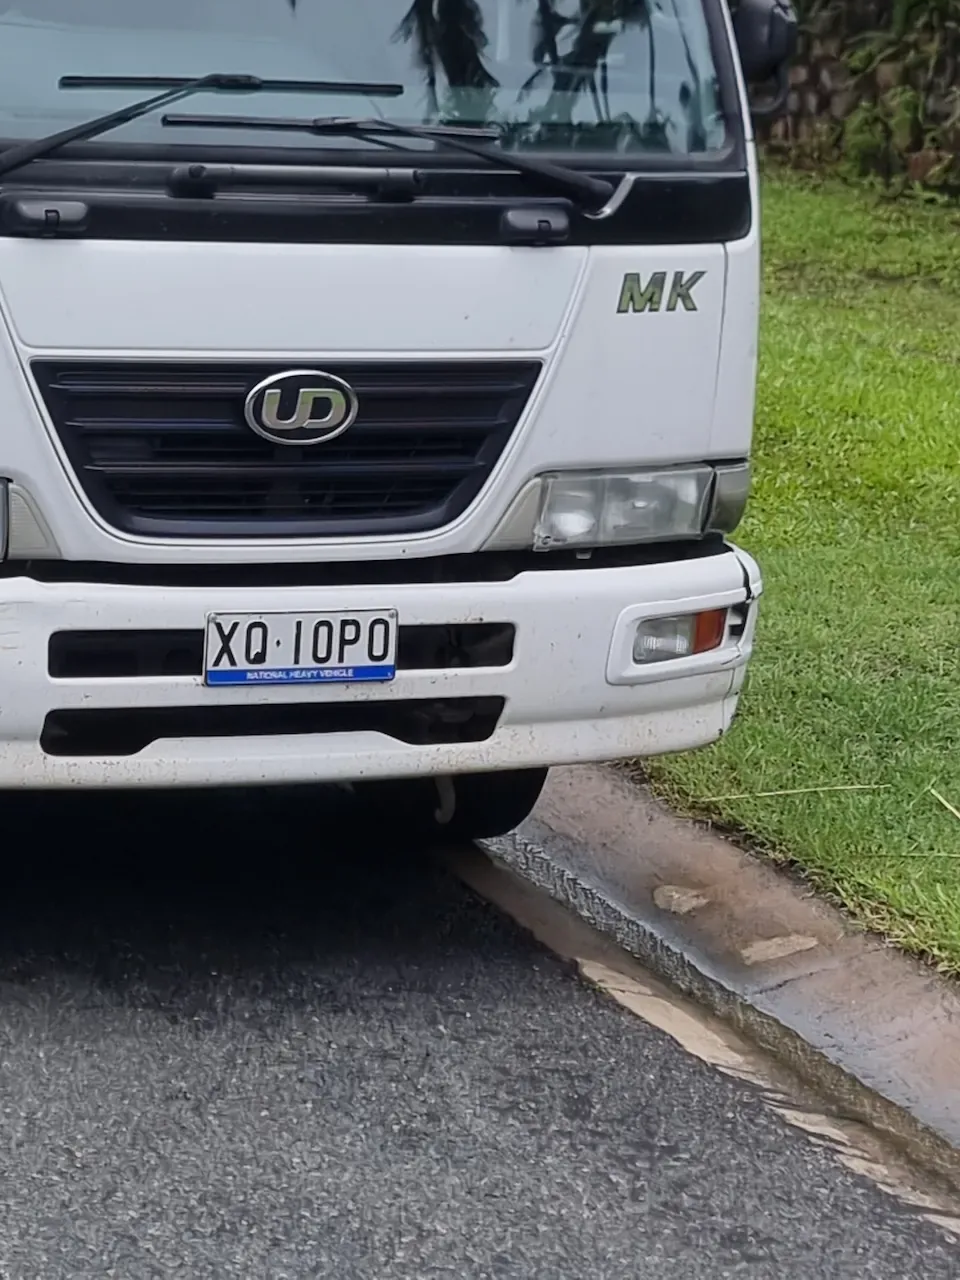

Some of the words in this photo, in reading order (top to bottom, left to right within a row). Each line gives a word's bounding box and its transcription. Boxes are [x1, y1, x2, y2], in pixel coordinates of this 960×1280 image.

[616, 271, 707, 313] MK
[261, 388, 346, 430] UD
[212, 621, 268, 667] XQ
[246, 671, 288, 680] NATIONAL
[289, 669, 318, 679] HEAVY
[320, 668, 354, 678] VEHICLE
